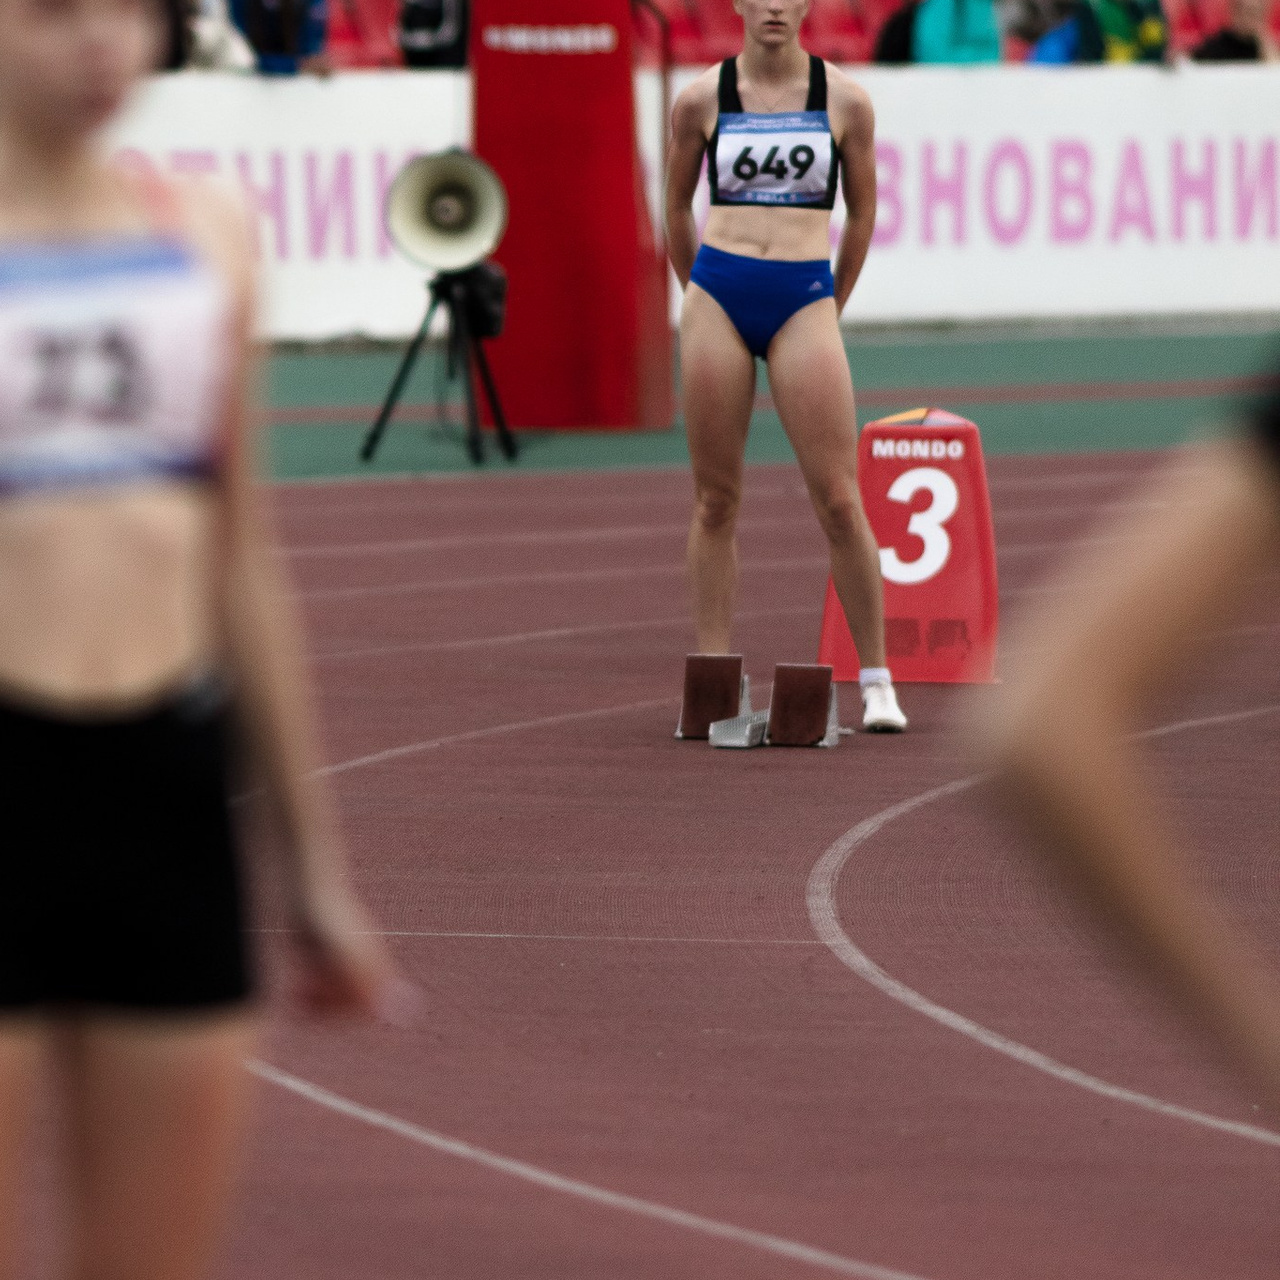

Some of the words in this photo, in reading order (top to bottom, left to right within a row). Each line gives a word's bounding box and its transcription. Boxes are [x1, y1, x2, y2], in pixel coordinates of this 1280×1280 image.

[732, 144, 815, 181] 649
[872, 439, 965, 460] MONDO
[878, 467, 959, 585] 3
